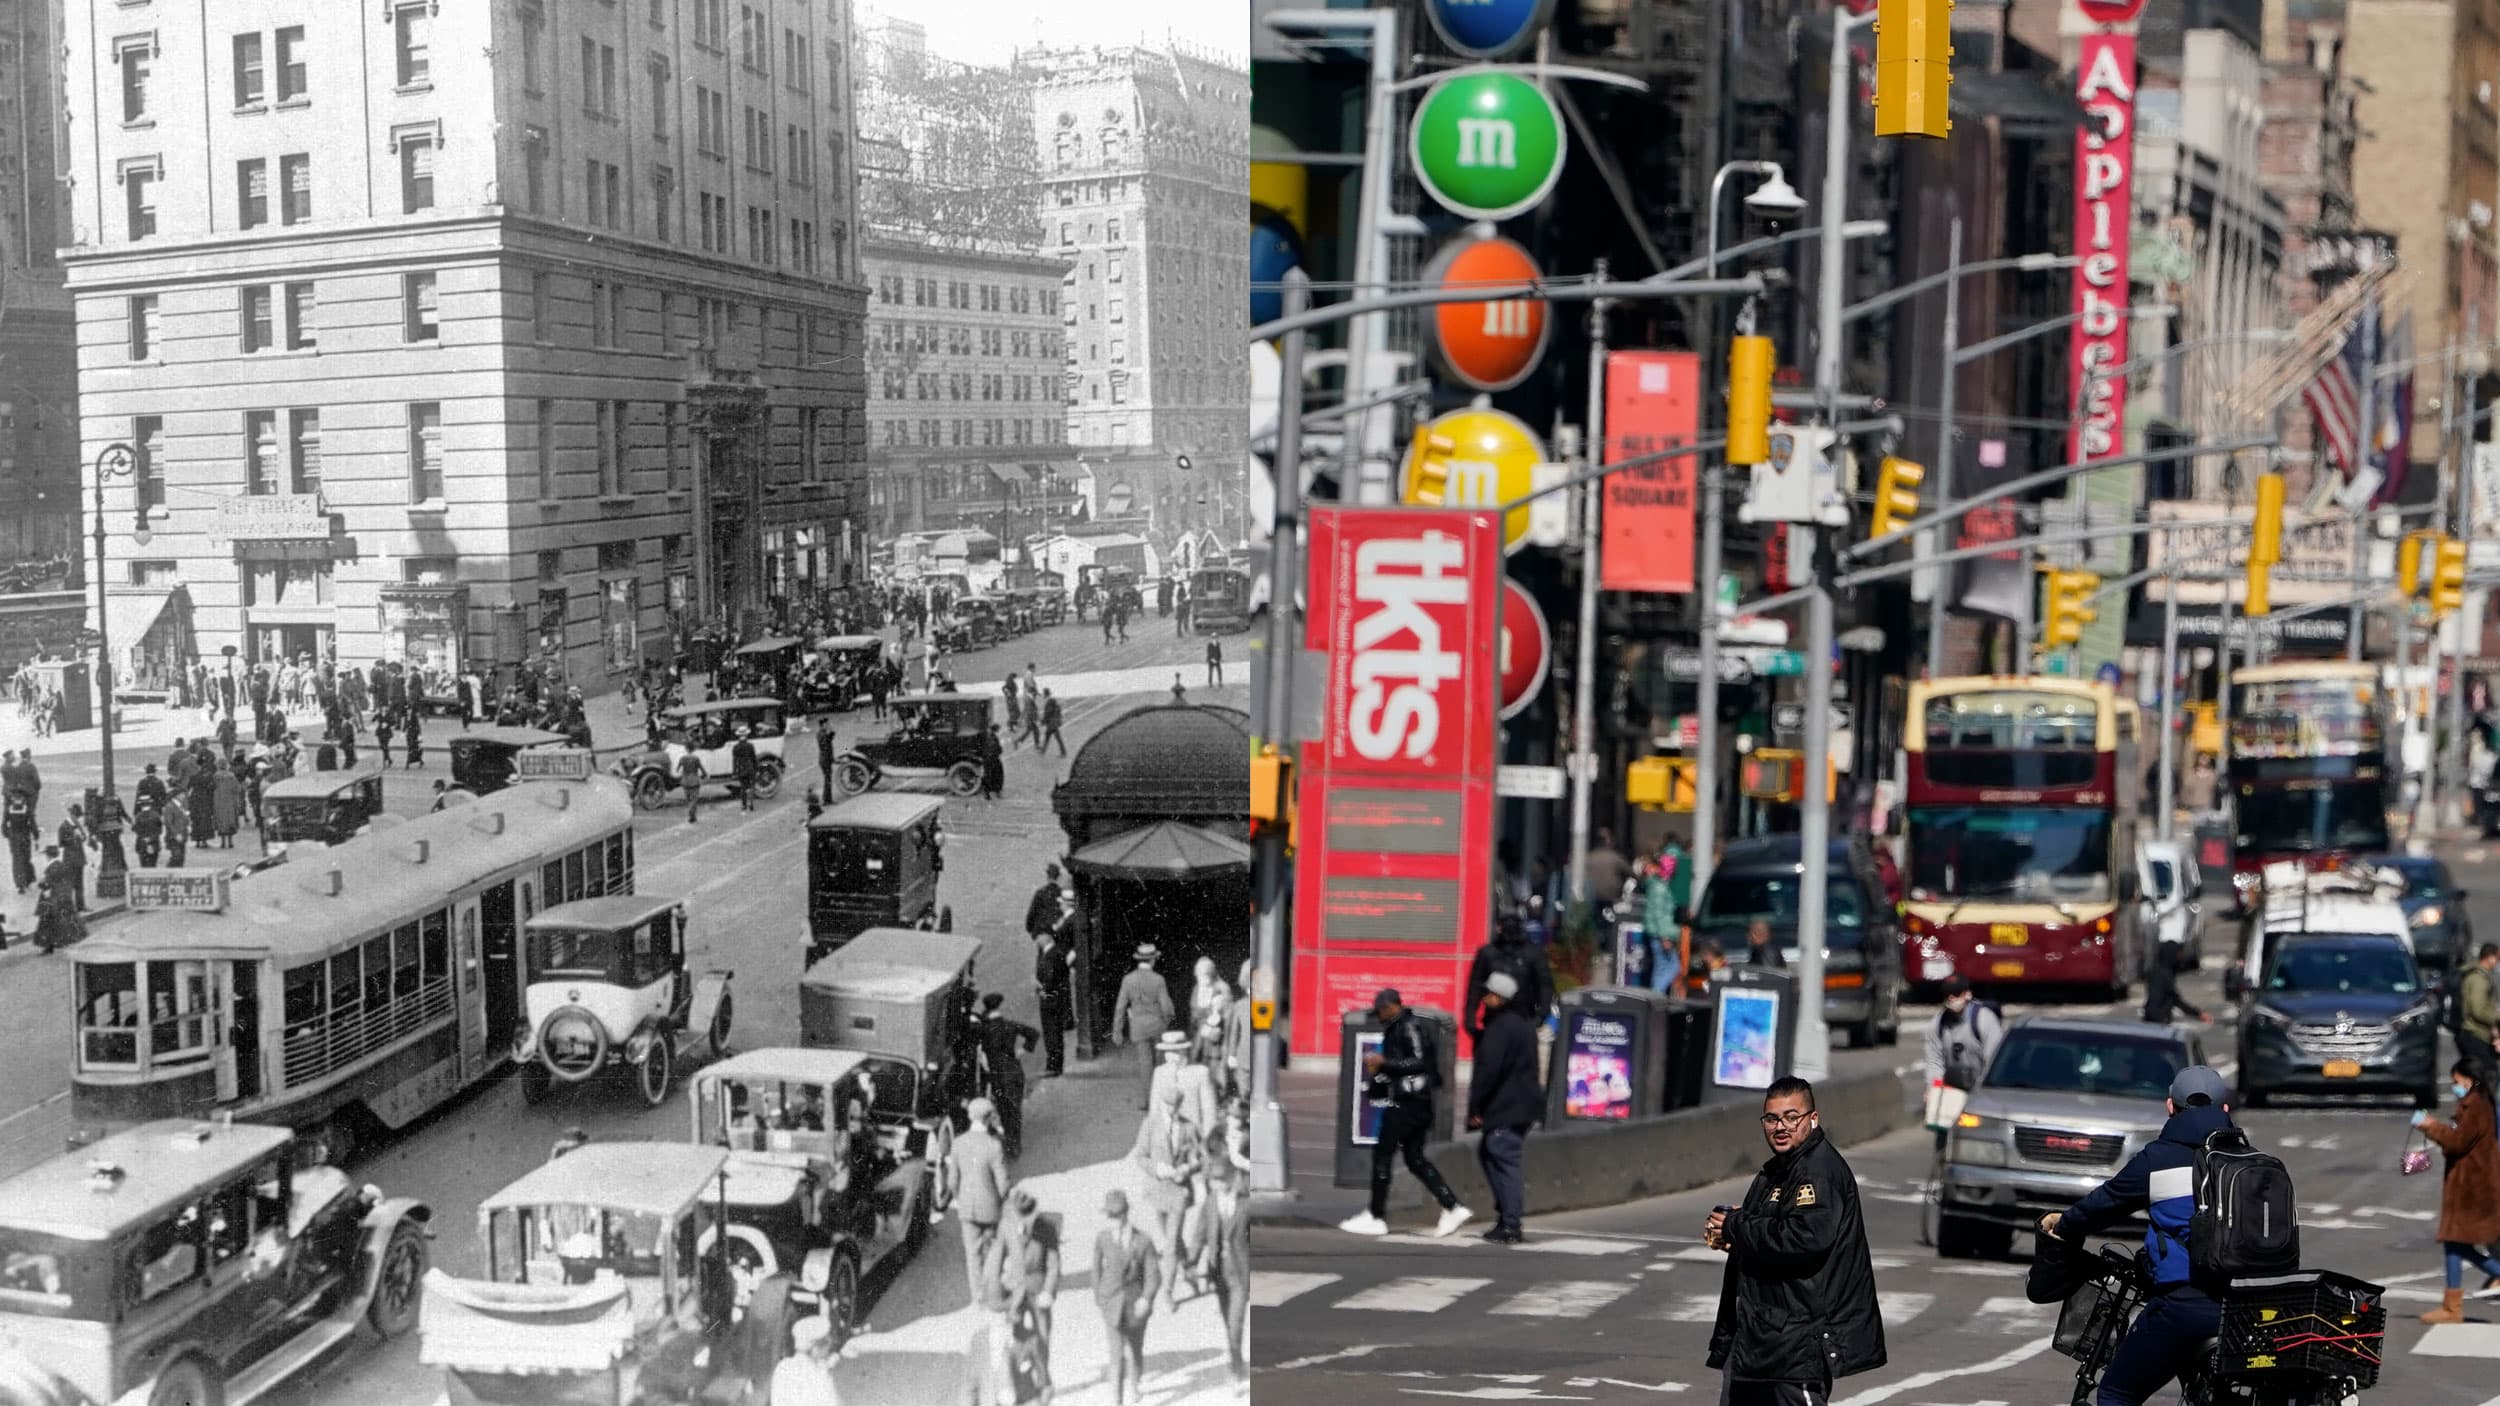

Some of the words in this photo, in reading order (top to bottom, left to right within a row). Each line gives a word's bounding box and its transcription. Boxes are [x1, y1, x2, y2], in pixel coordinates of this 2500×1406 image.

[1457, 118, 1516, 168] m
[1611, 486, 1688, 506] SQUARE
[1350, 529, 1469, 761] tkts
